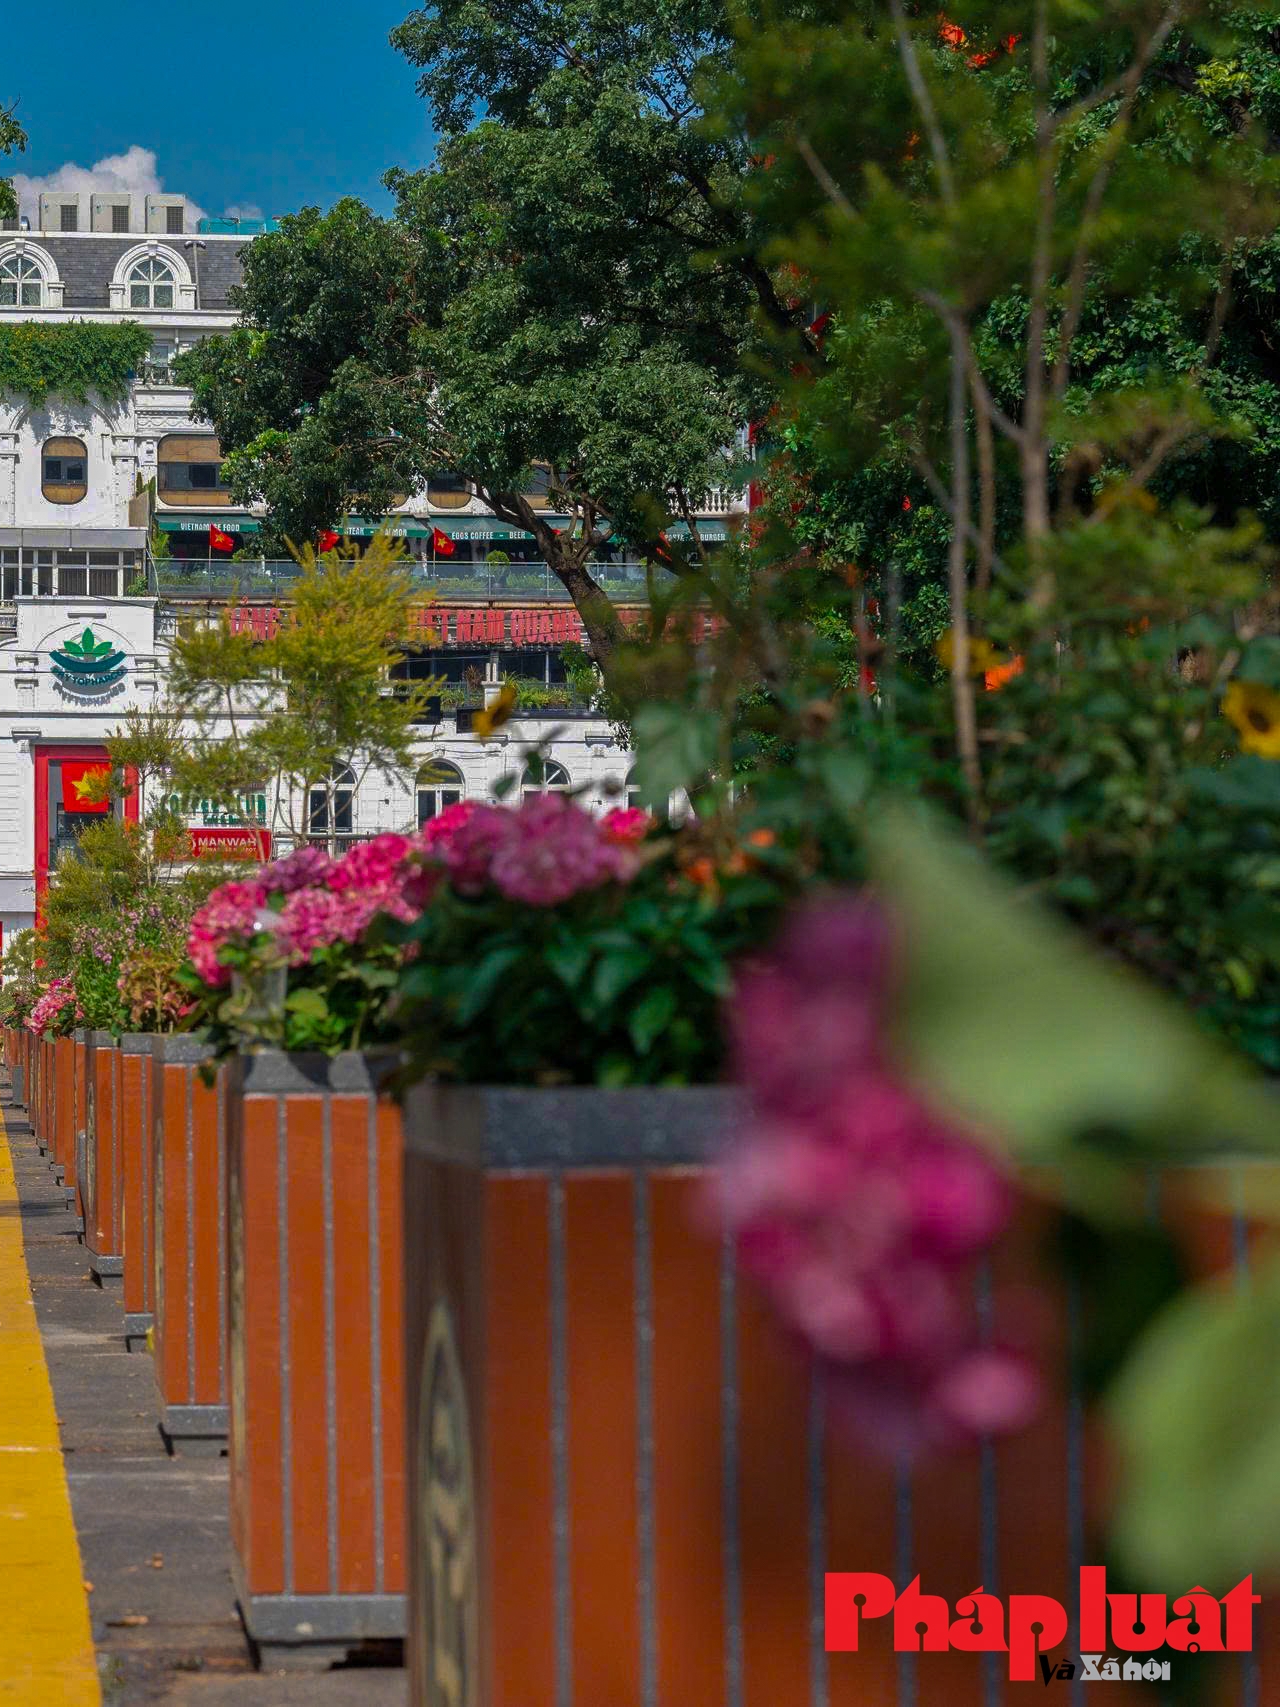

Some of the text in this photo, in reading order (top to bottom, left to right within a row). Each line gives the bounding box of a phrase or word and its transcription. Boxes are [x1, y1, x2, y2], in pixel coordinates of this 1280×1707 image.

[180, 522, 240, 532] VIETNAMSE FOOD
[470, 531, 494, 540] COFFEE
[509, 531, 526, 539] BEER
[700, 533, 726, 542] BURGER
[456, 609, 505, 643] NAM
[511, 608, 582, 648] QUANG
[198, 837, 257, 847] MANWAH
